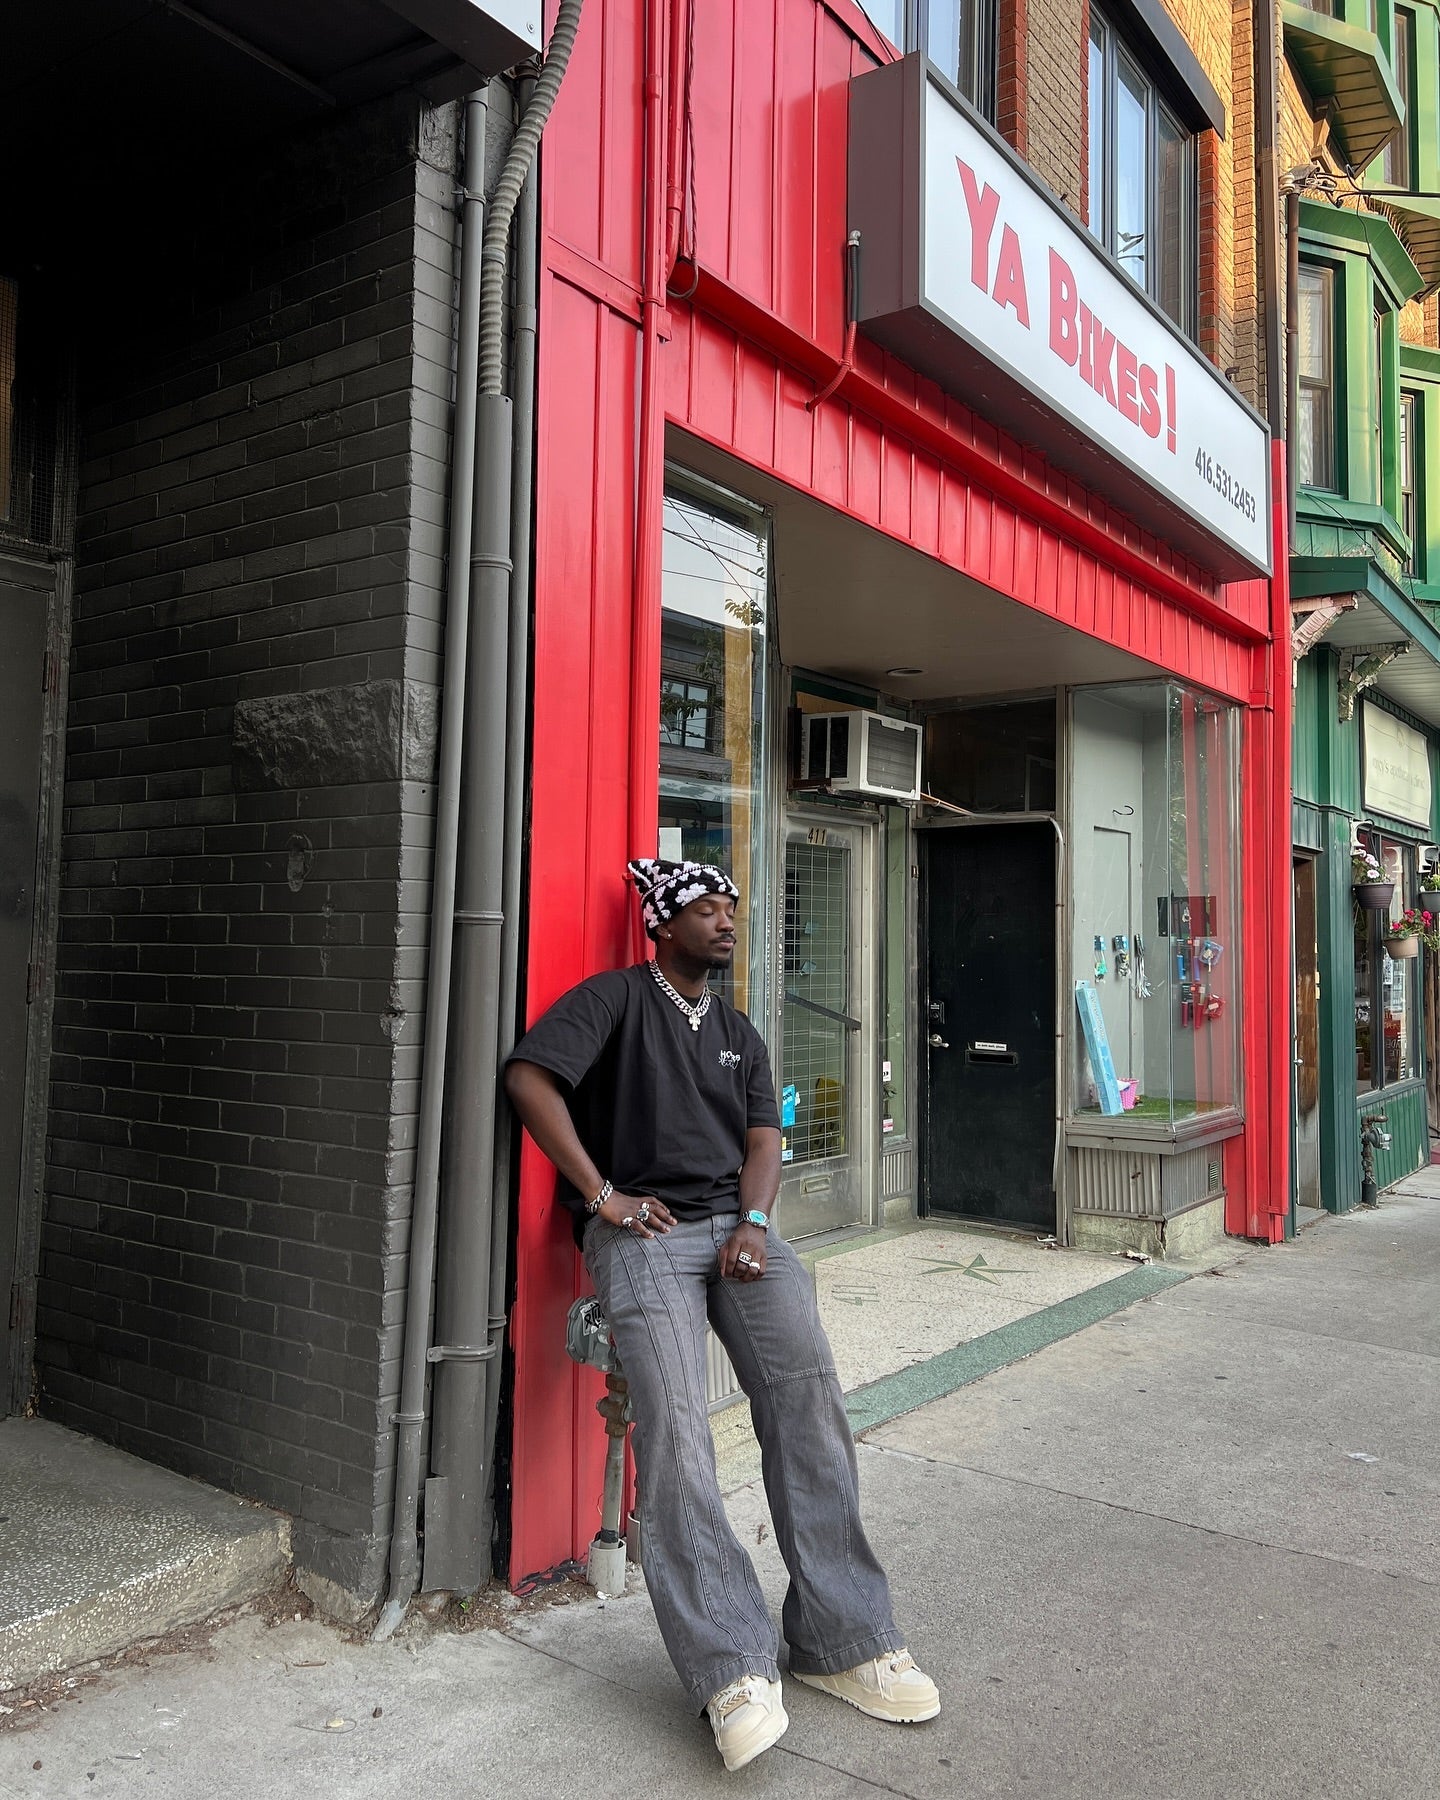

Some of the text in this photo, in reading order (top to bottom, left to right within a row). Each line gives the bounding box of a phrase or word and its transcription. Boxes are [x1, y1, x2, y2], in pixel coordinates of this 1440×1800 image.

[955, 155, 1177, 456] YA BIKES!
[1194, 446, 1256, 524] 416.531.2453
[807, 827, 826, 845] 411
